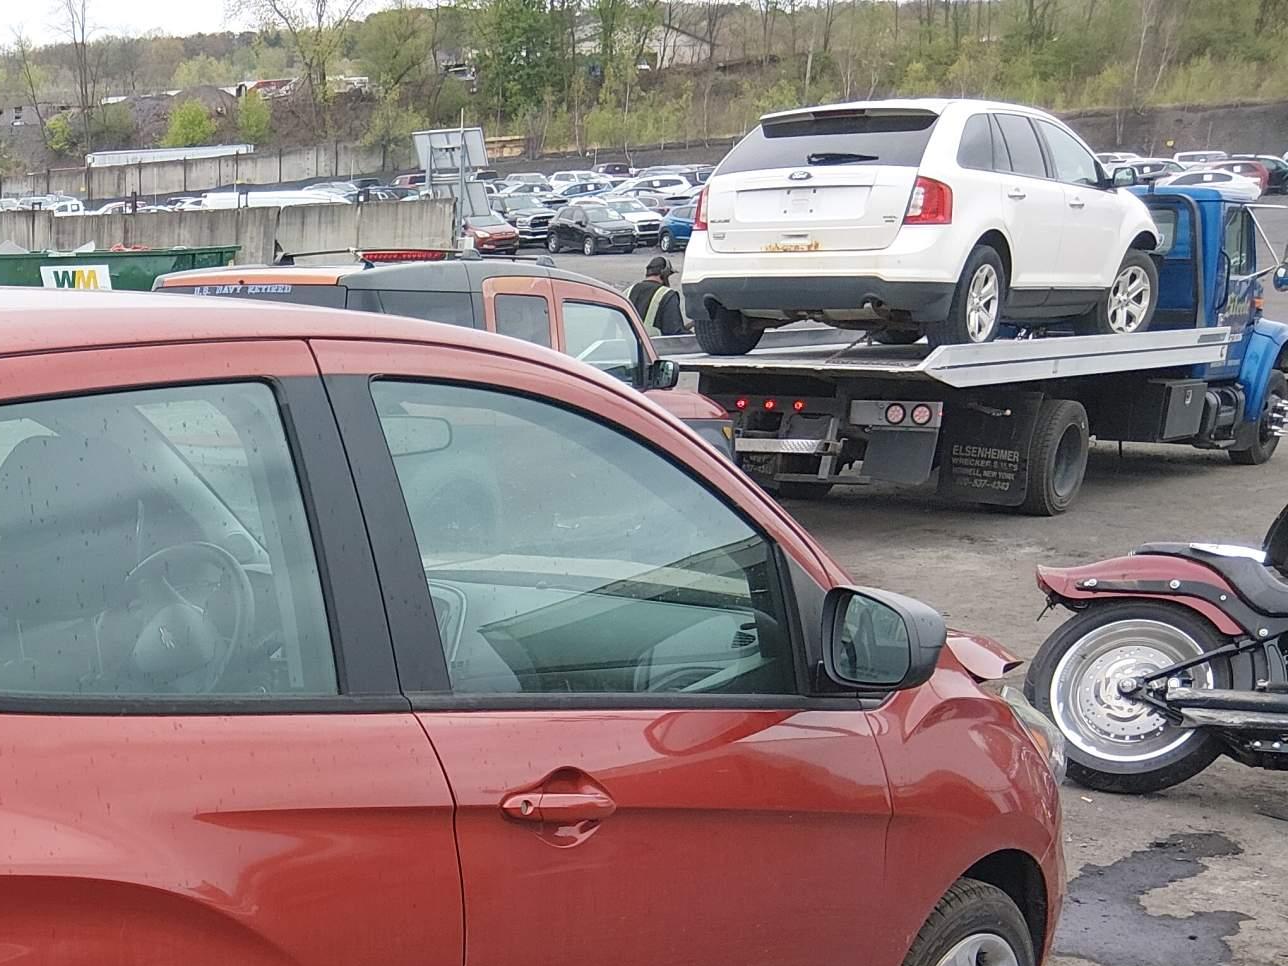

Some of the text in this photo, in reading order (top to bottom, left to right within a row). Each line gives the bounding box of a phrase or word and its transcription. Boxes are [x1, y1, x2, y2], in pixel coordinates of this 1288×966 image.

[53, 270, 99, 288] WM
[194, 284, 292, 296] U.S. NAVY RETIRED
[953, 445, 1019, 462] ELSENHEIMER
[982, 470, 997, 478] NEW
[999, 471, 1015, 480] YORK
